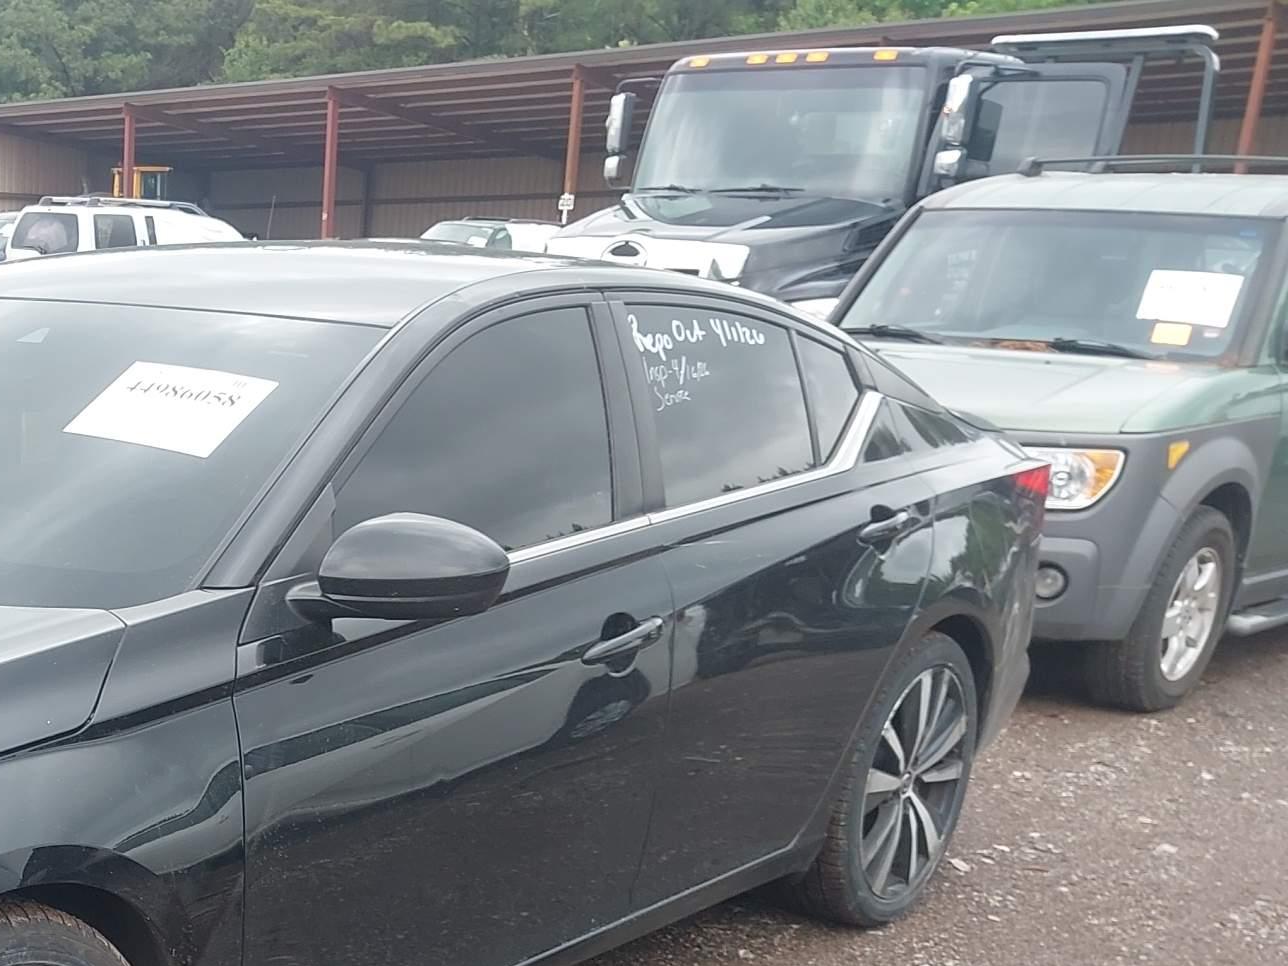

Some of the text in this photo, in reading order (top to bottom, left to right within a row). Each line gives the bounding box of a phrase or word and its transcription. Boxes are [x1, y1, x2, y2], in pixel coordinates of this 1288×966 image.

[627, 313, 673, 361] Repo
[671, 319, 706, 343] Out
[126, 380, 241, 407] 44986058
